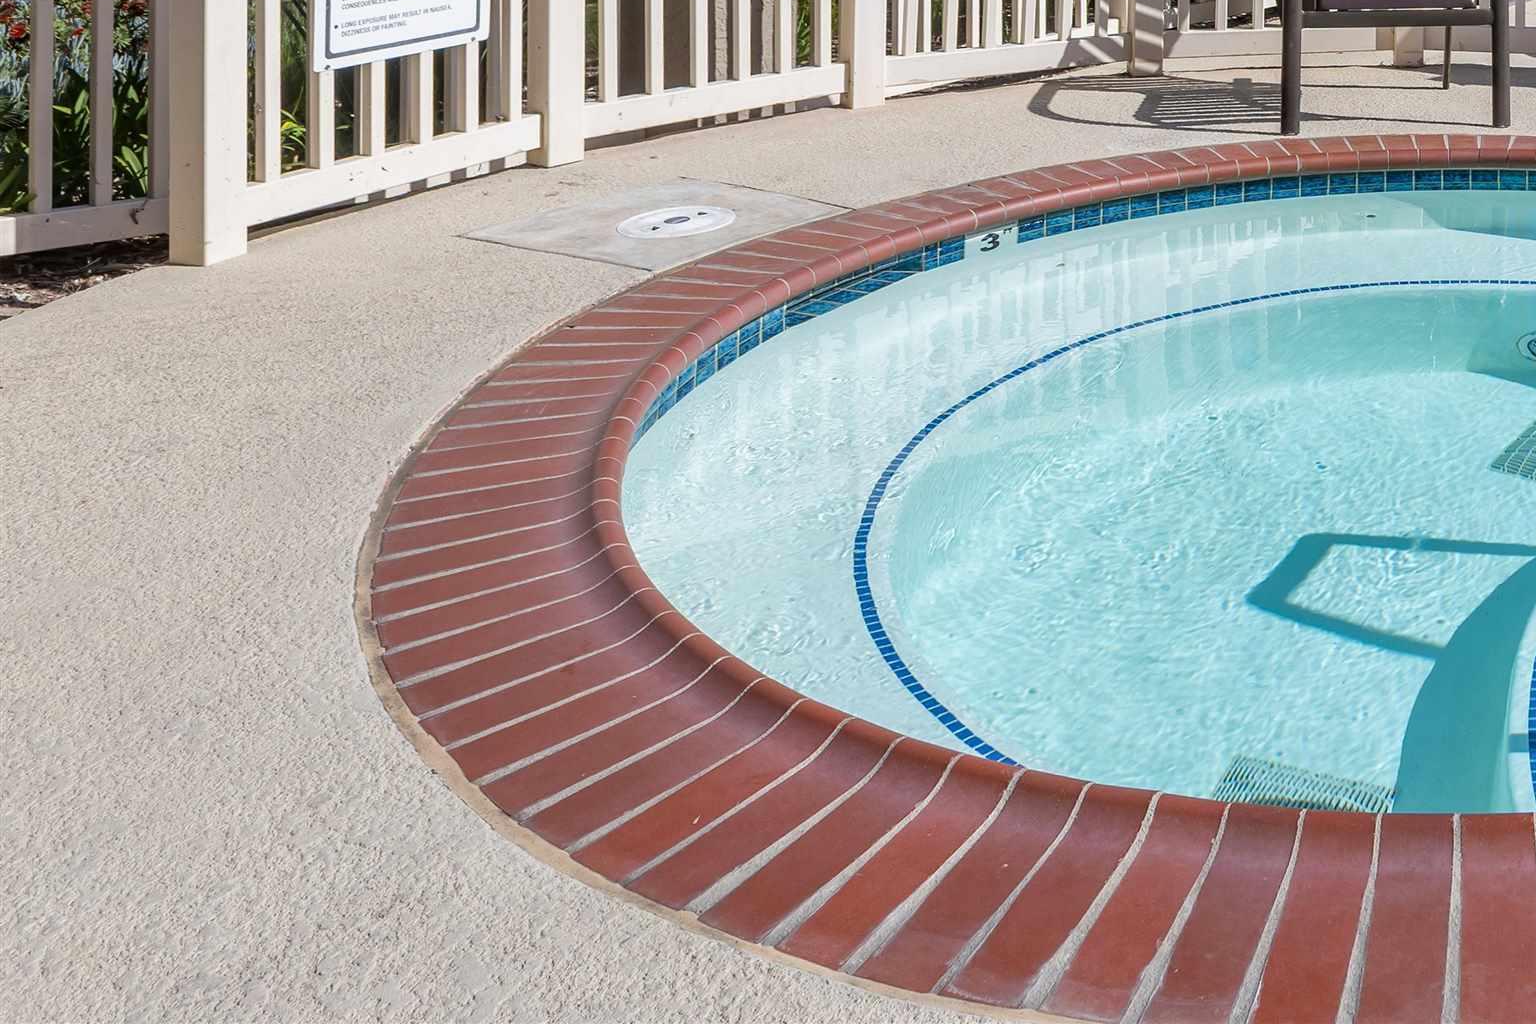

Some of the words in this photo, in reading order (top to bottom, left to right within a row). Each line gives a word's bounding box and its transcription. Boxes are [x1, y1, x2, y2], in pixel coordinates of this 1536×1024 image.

[341, 20, 357, 28] LONG
[359, 16, 386, 25] EXPOSURE
[341, 26, 370, 37] DIZZINESS
[980, 232, 1000, 252] 3
